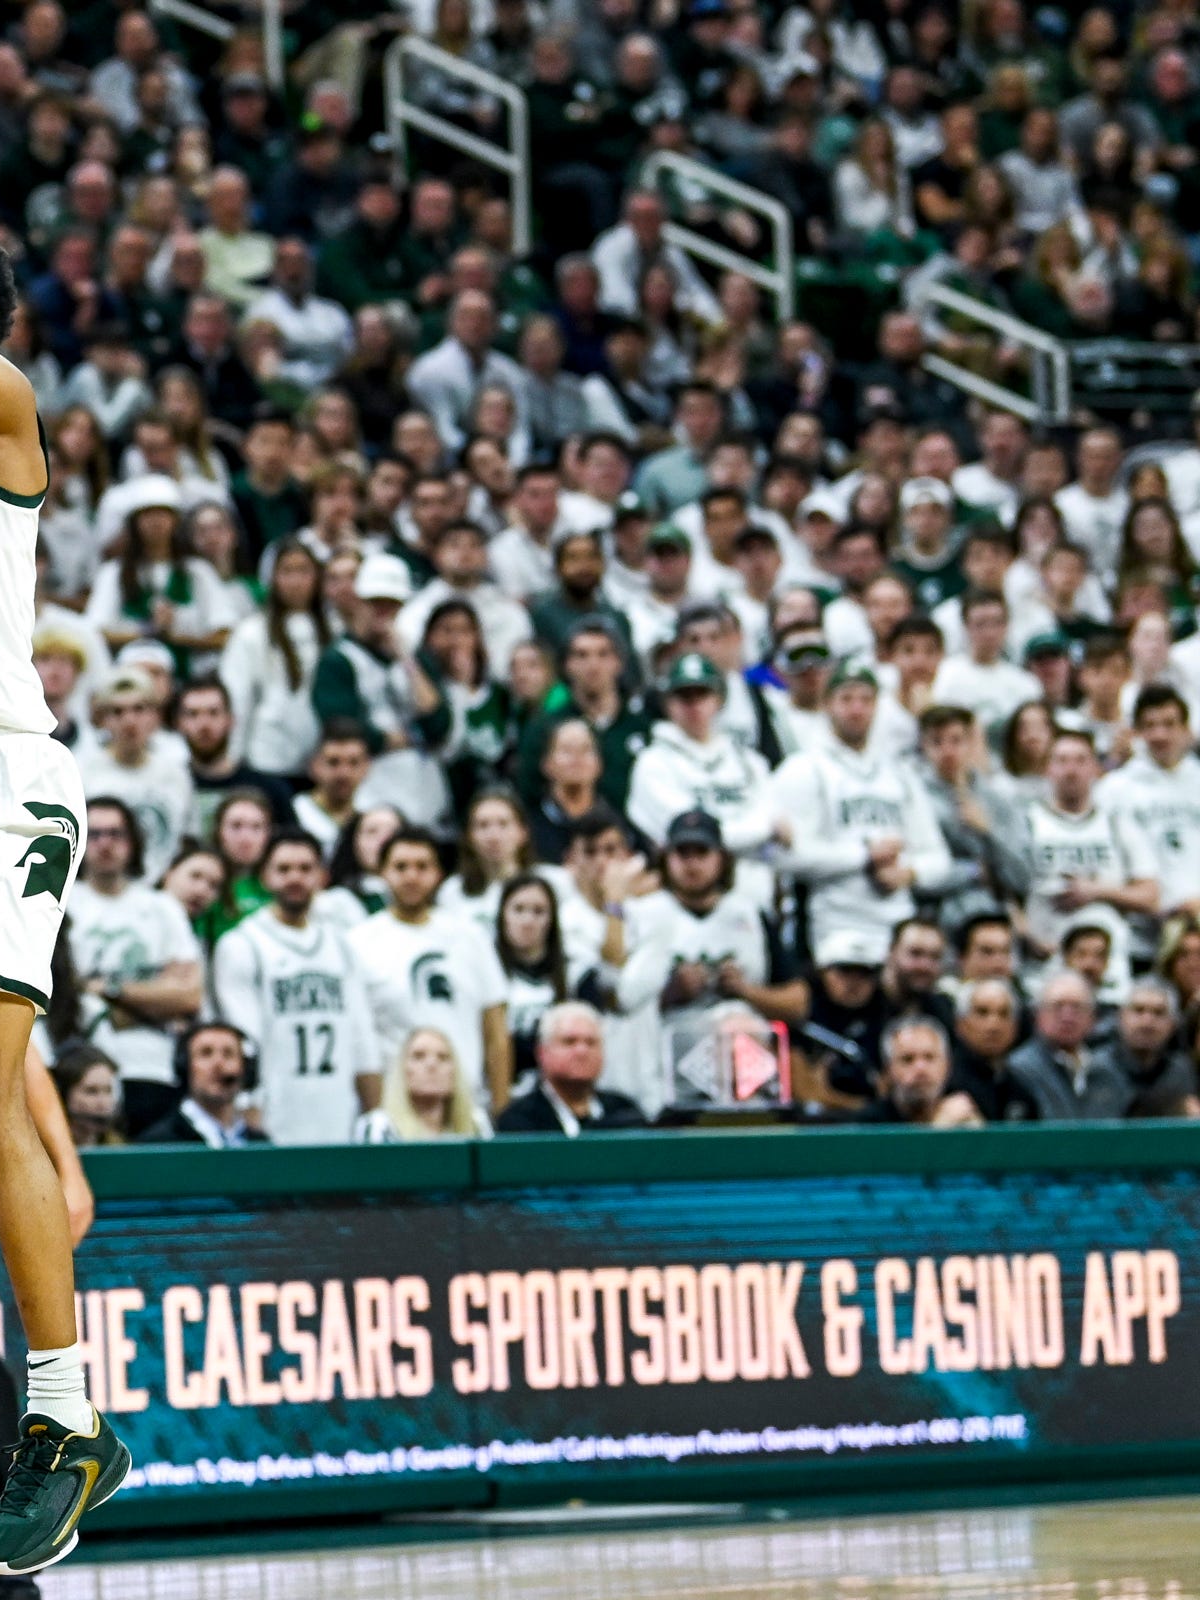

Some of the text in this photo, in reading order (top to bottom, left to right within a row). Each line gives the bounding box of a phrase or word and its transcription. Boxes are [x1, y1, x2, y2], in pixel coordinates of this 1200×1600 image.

[295, 1023, 336, 1076] 12
[75, 1248, 1182, 1413] HE CAESARS SPORTSBOOK & CASINO APP
